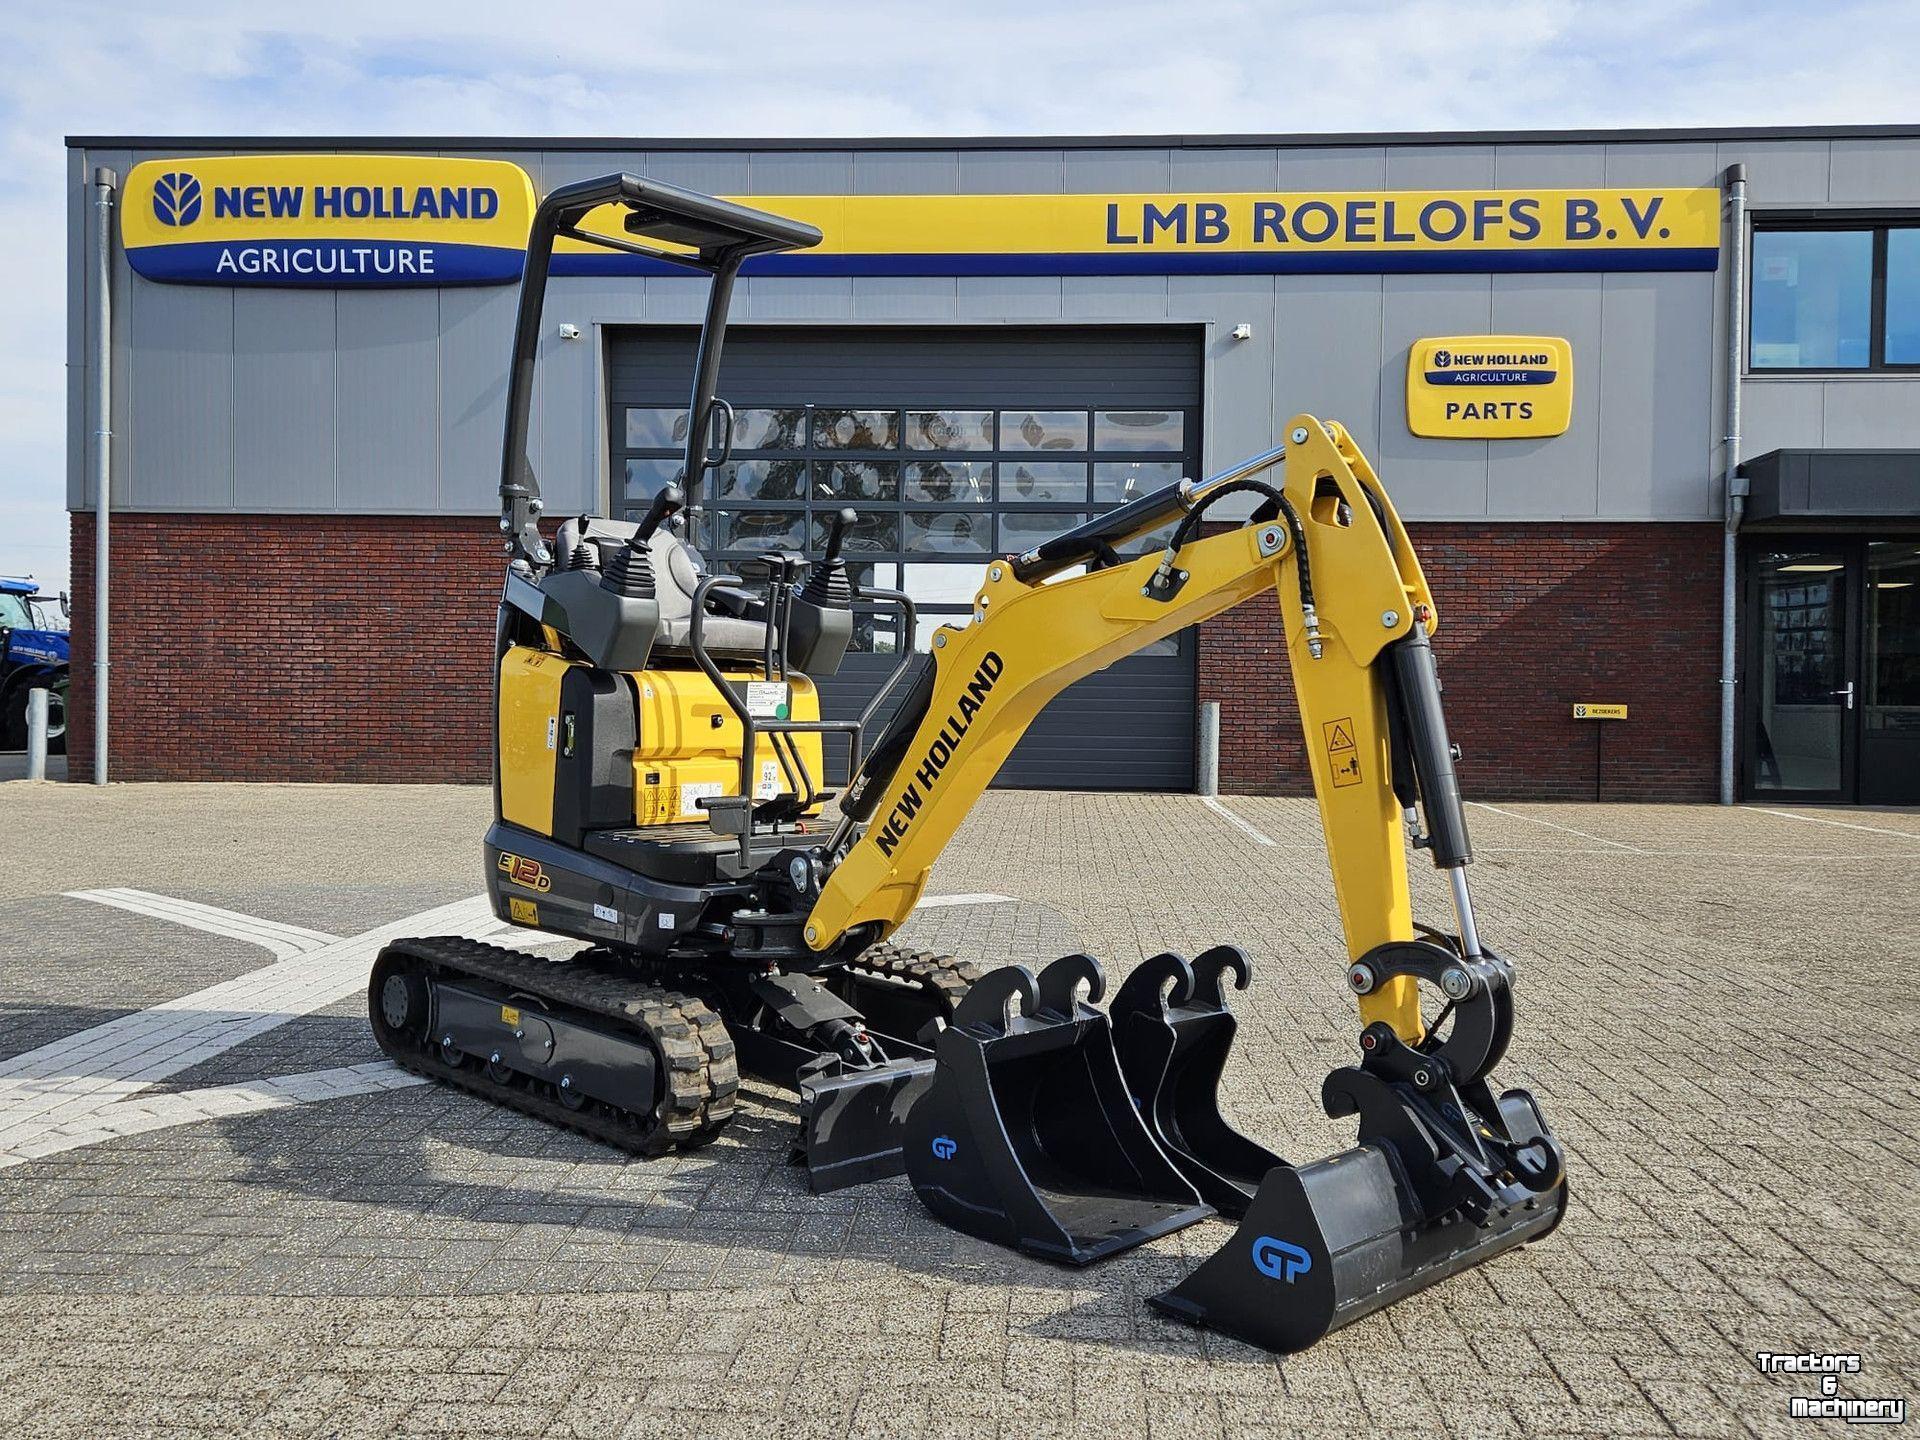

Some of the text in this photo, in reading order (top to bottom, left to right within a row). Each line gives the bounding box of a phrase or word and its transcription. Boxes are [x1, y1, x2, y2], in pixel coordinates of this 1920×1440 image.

[214, 186, 499, 220] NEW HOLLAND
[1105, 196, 1670, 245] LMB ROELOFS B.V.
[215, 248, 435, 274] AGRICULTURE
[1454, 355, 1548, 365] NEW HOLLAND
[1454, 372, 1528, 382] AGRICULTURE
[1446, 402, 1533, 420] PARTS
[875, 650, 1005, 858] NEW HOLLAND
[931, 1136, 958, 1161] GP
[1251, 1235, 1313, 1285] GP
